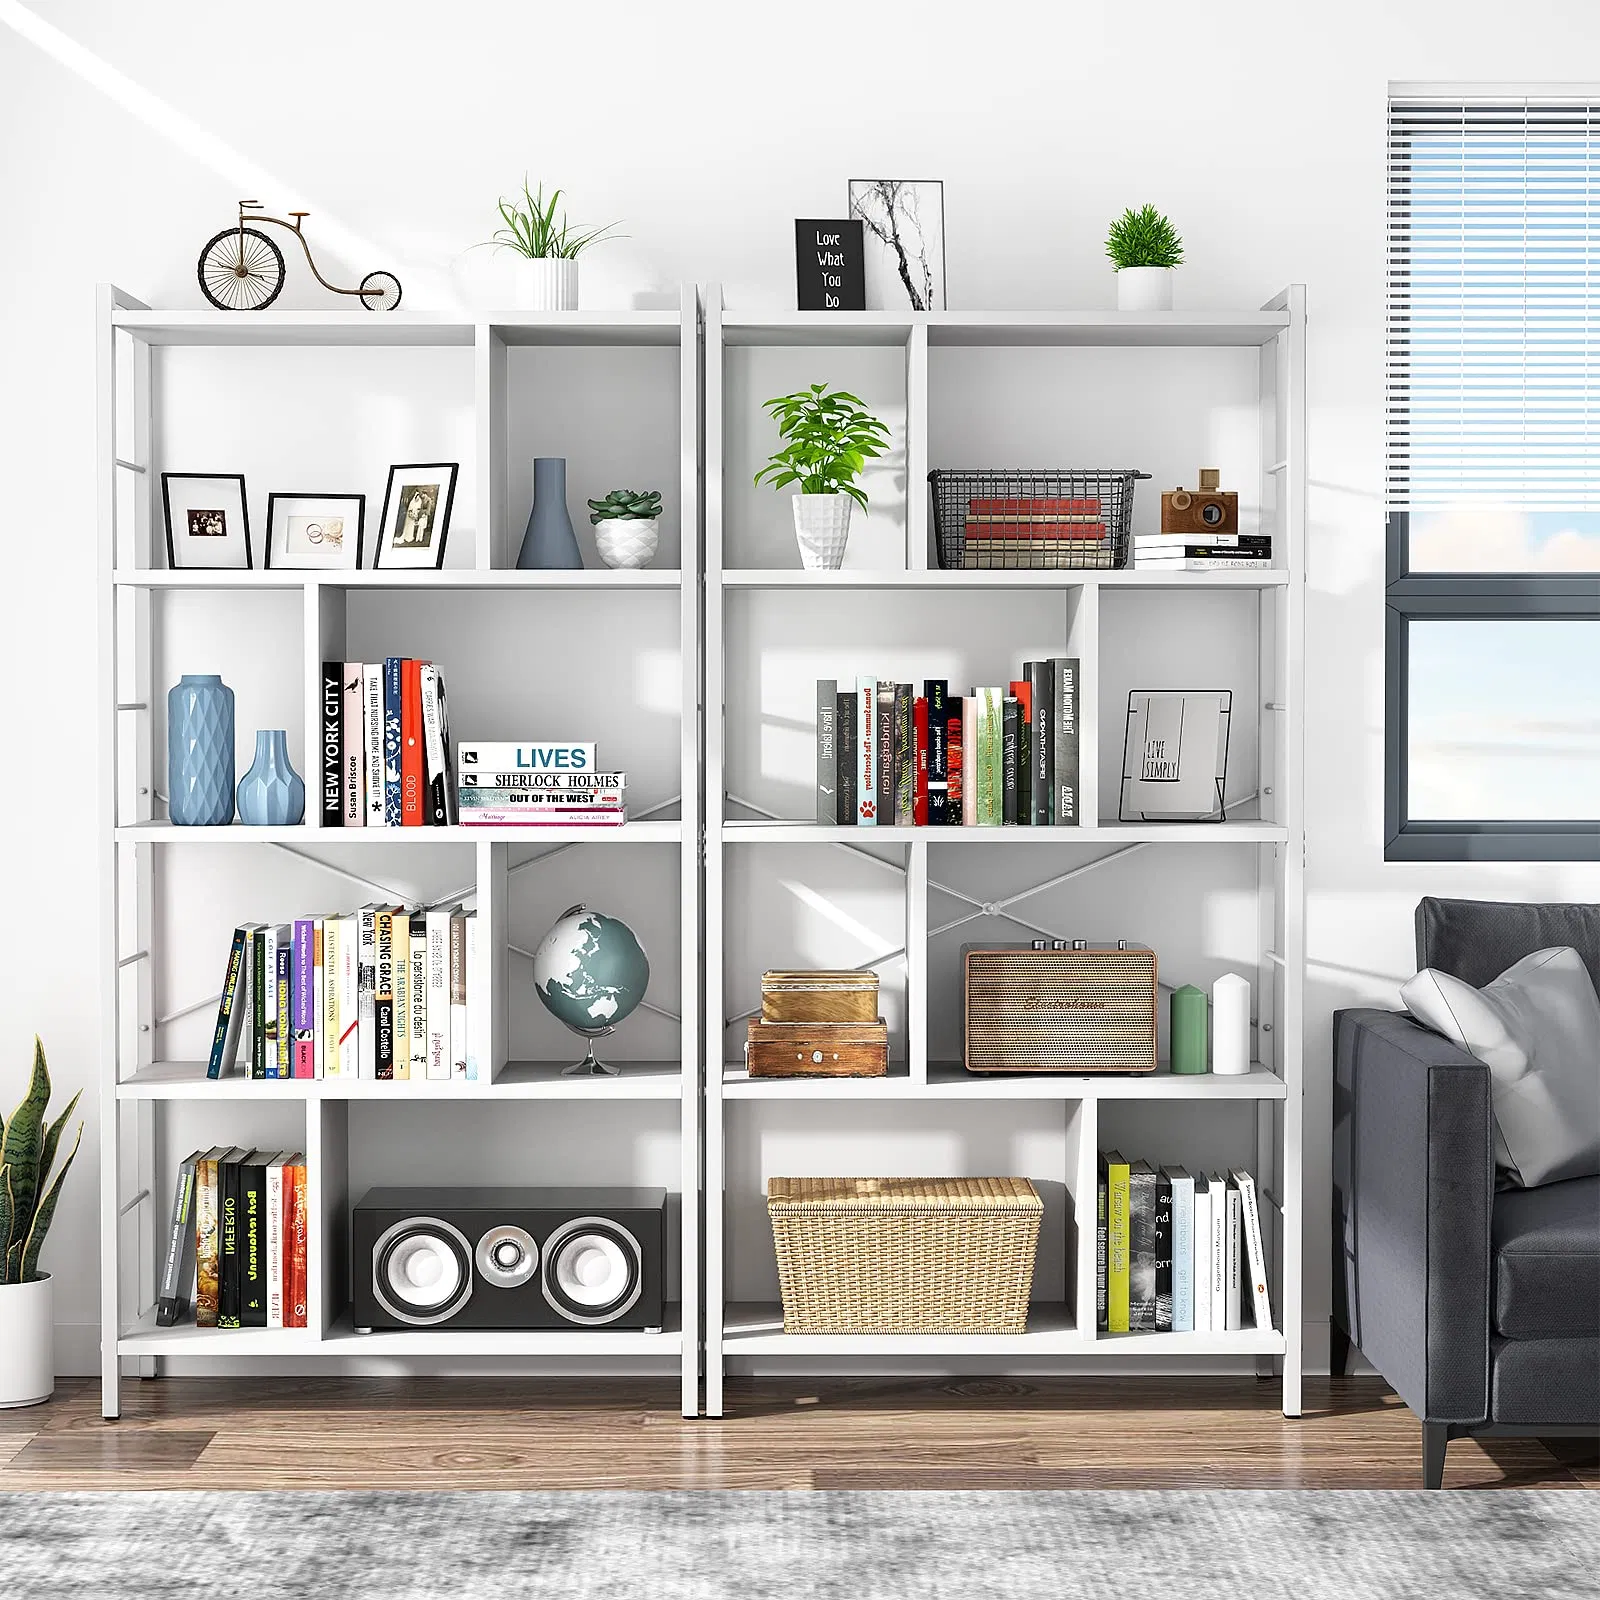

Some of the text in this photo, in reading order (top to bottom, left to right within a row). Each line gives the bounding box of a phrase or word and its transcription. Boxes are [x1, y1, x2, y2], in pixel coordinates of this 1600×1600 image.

[816, 231, 840, 246] Love
[817, 251, 845, 266] What
[821, 272, 841, 287] You
[825, 292, 839, 308] Do
[325, 678, 339, 811] NEW YORK CITY
[1147, 741, 1165, 758] LIVE
[517, 749, 586, 768] LIVES
[1146, 762, 1176, 778] SIMPLY
[348, 755, 358, 820] Susan Briscoe
[495, 775, 619, 787] SHERLOCK HOLMES
[406, 775, 416, 811] BLOOD
[363, 912, 375, 946] New York
[231, 950, 241, 972] MAKING
[380, 914, 392, 996] CHASING GRACE
[223, 996, 232, 1015] NEWS
[397, 959, 406, 1038] THE ARABIAN NIGHTS
[279, 980, 287, 1076] HONG KONG NIGHTS
[380, 1006, 391, 1059] Carol Costello
[1098, 1226, 1106, 1240] Feel
[1114, 1180, 1126, 1273] Warsaw on the beach
[1098, 1241, 1106, 1265] secure
[1097, 1273, 1105, 1288] your
[1098, 1289, 1106, 1310] house
[1180, 1298, 1189, 1321] know
